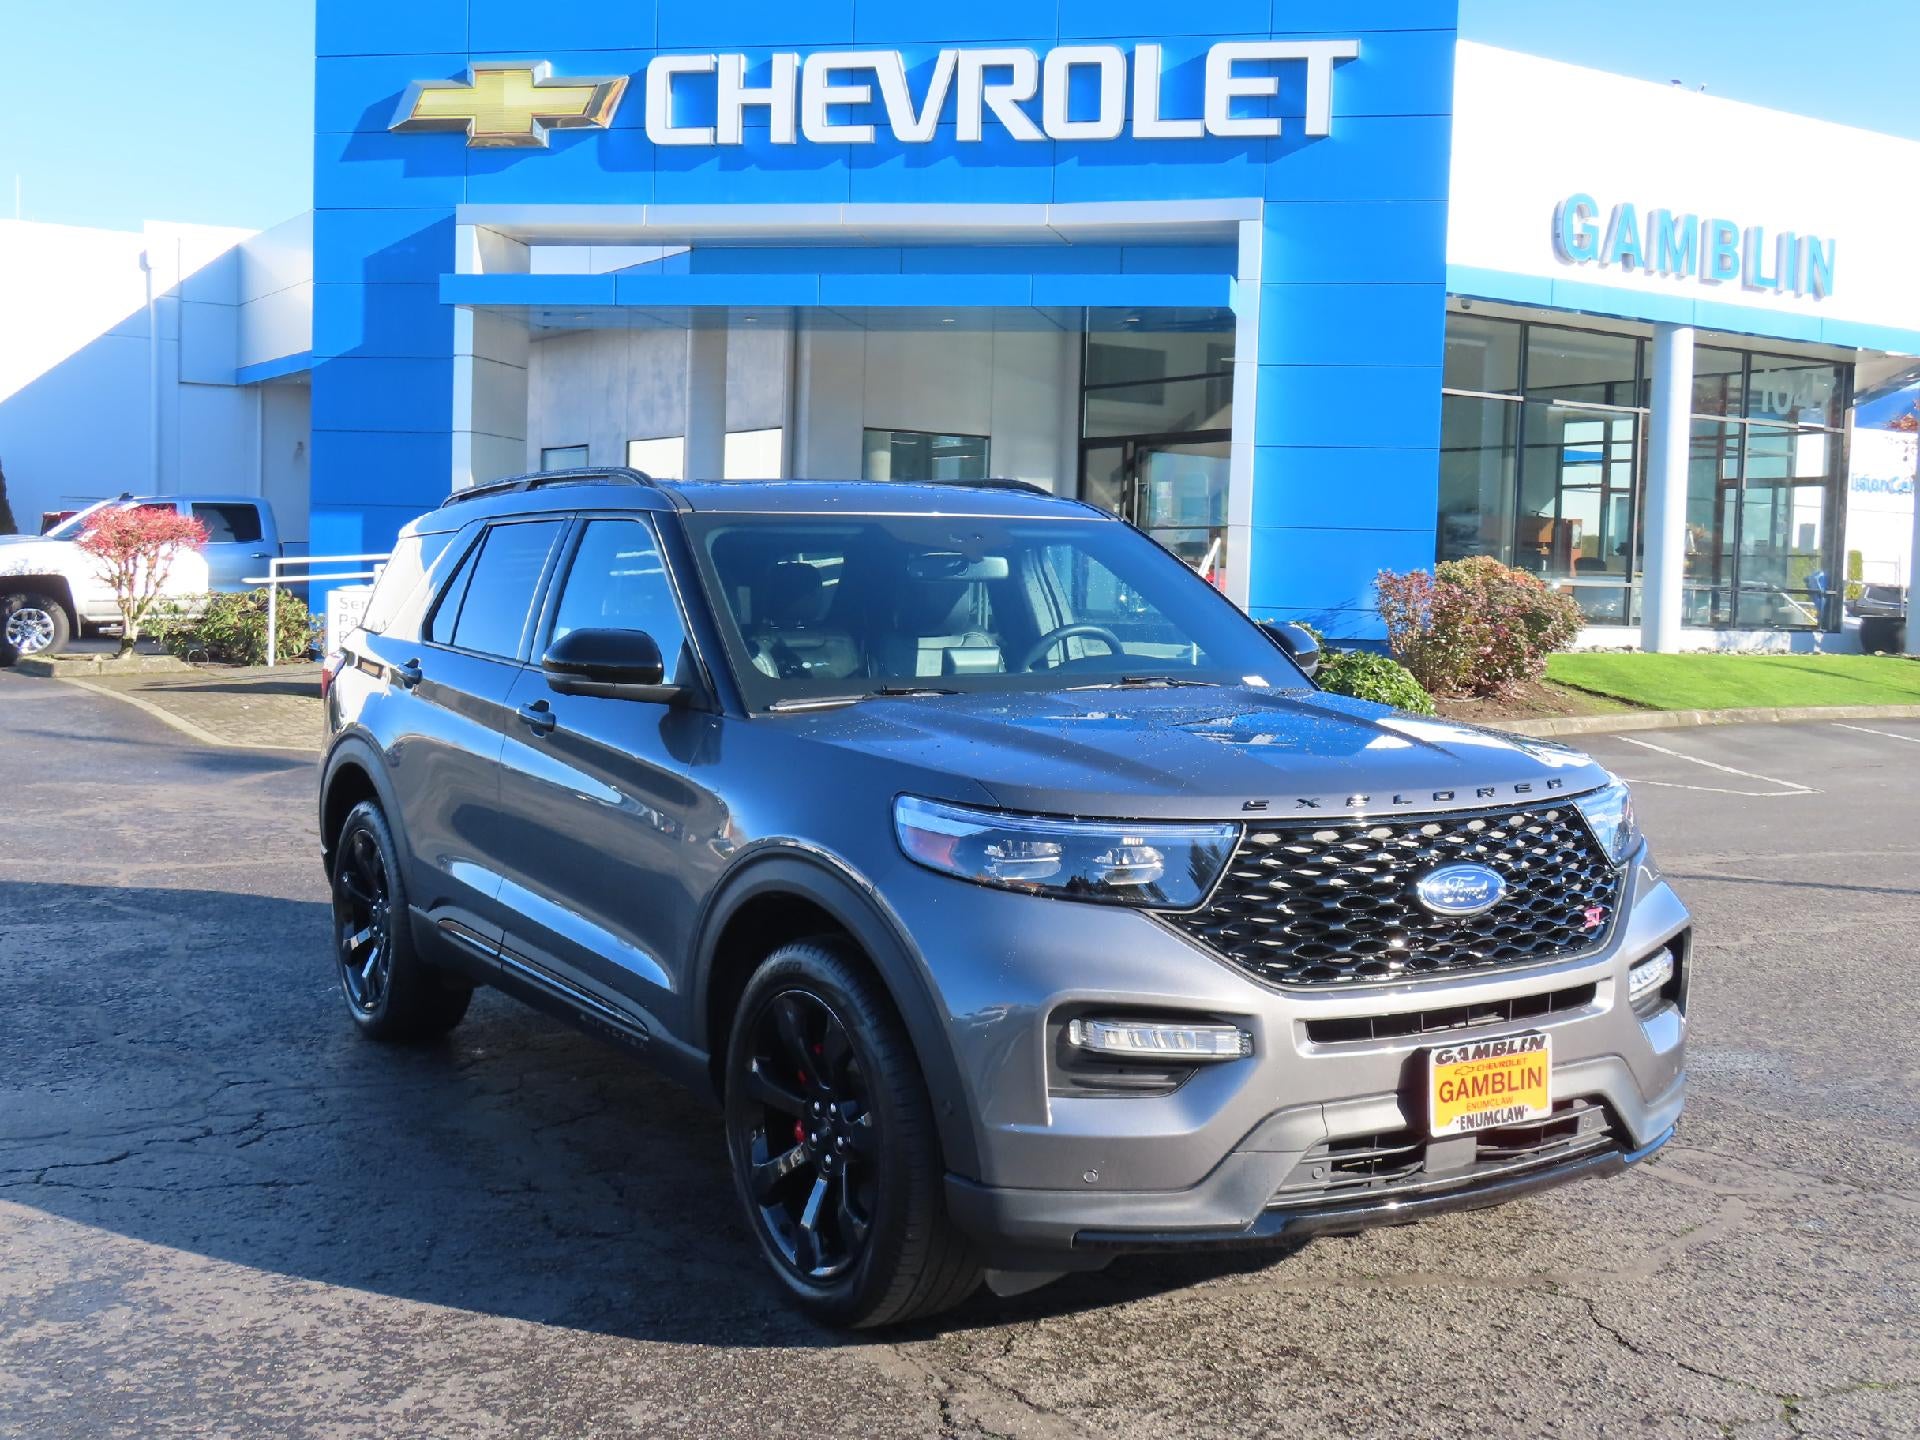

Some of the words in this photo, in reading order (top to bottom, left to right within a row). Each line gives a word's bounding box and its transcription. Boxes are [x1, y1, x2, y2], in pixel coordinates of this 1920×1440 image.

[645, 39, 1360, 145] CHEVROLET
[1551, 192, 1836, 302] GAMBLIN
[1242, 778, 1563, 812] EXPLORER
[1443, 875, 1488, 903] Ford
[1435, 1035, 1547, 1065] GAMBLIN
[1476, 1057, 1528, 1071] CHEVROLET
[1438, 1066, 1542, 1104] GAMBLIN
[1459, 1105, 1526, 1131] ENUMCLAW
[1466, 1096, 1515, 1112] ENUMCLAW
